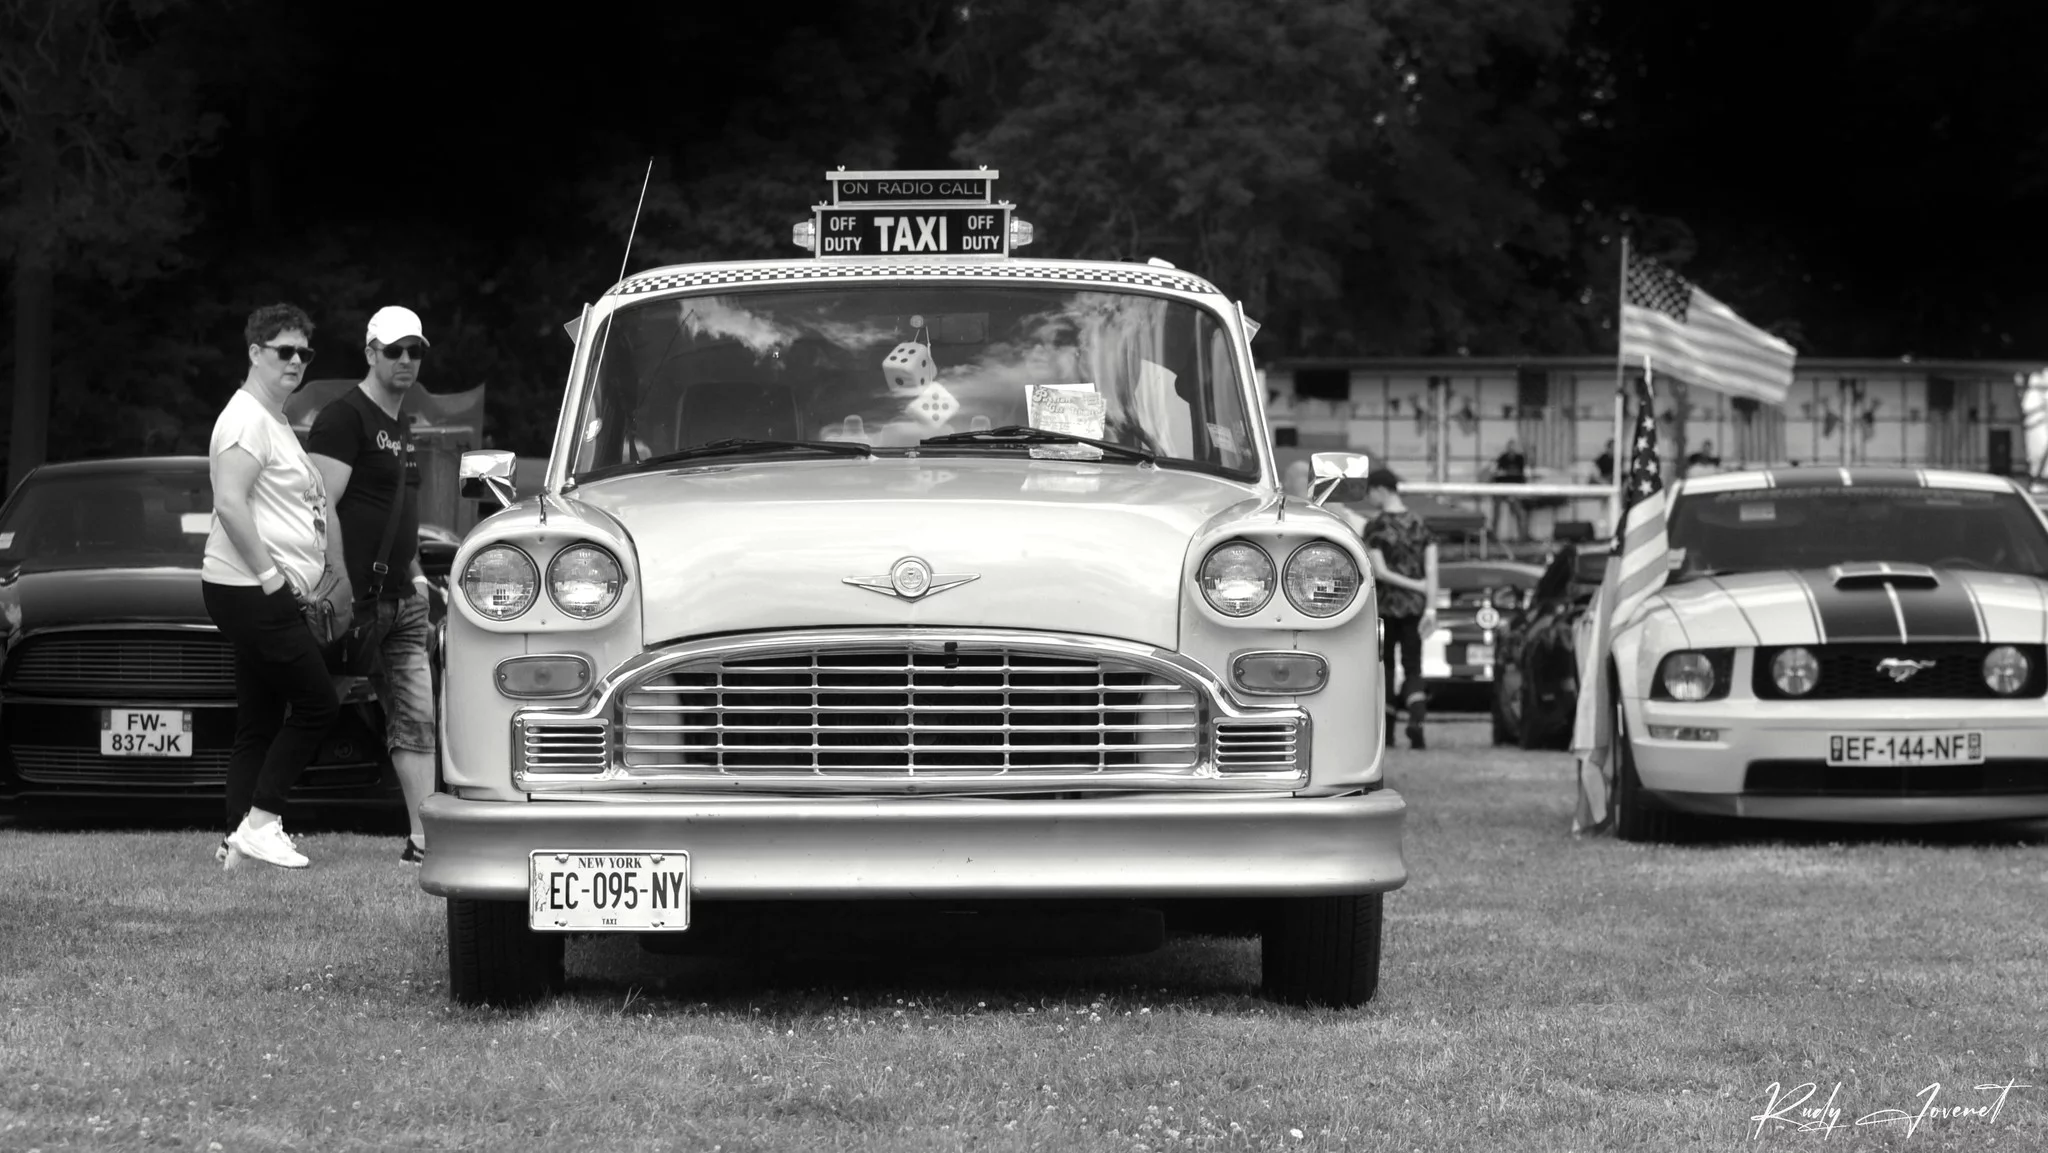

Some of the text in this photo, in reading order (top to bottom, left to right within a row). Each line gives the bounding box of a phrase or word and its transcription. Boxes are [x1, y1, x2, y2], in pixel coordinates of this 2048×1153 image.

[842, 182, 983, 195] ON RADIO CALL
[829, 216, 856, 231] OFF
[967, 215, 994, 230] OFF
[873, 216, 947, 252] TAXI
[824, 237, 862, 251] DUTY
[962, 235, 1000, 250] DUTY
[128, 714, 166, 731] FW-
[112, 734, 180, 751] 837-JK
[1847, 735, 1965, 760] EF-144-NF
[578, 857, 642, 869] NEW YORK
[550, 872, 684, 909] EC-095-NY
